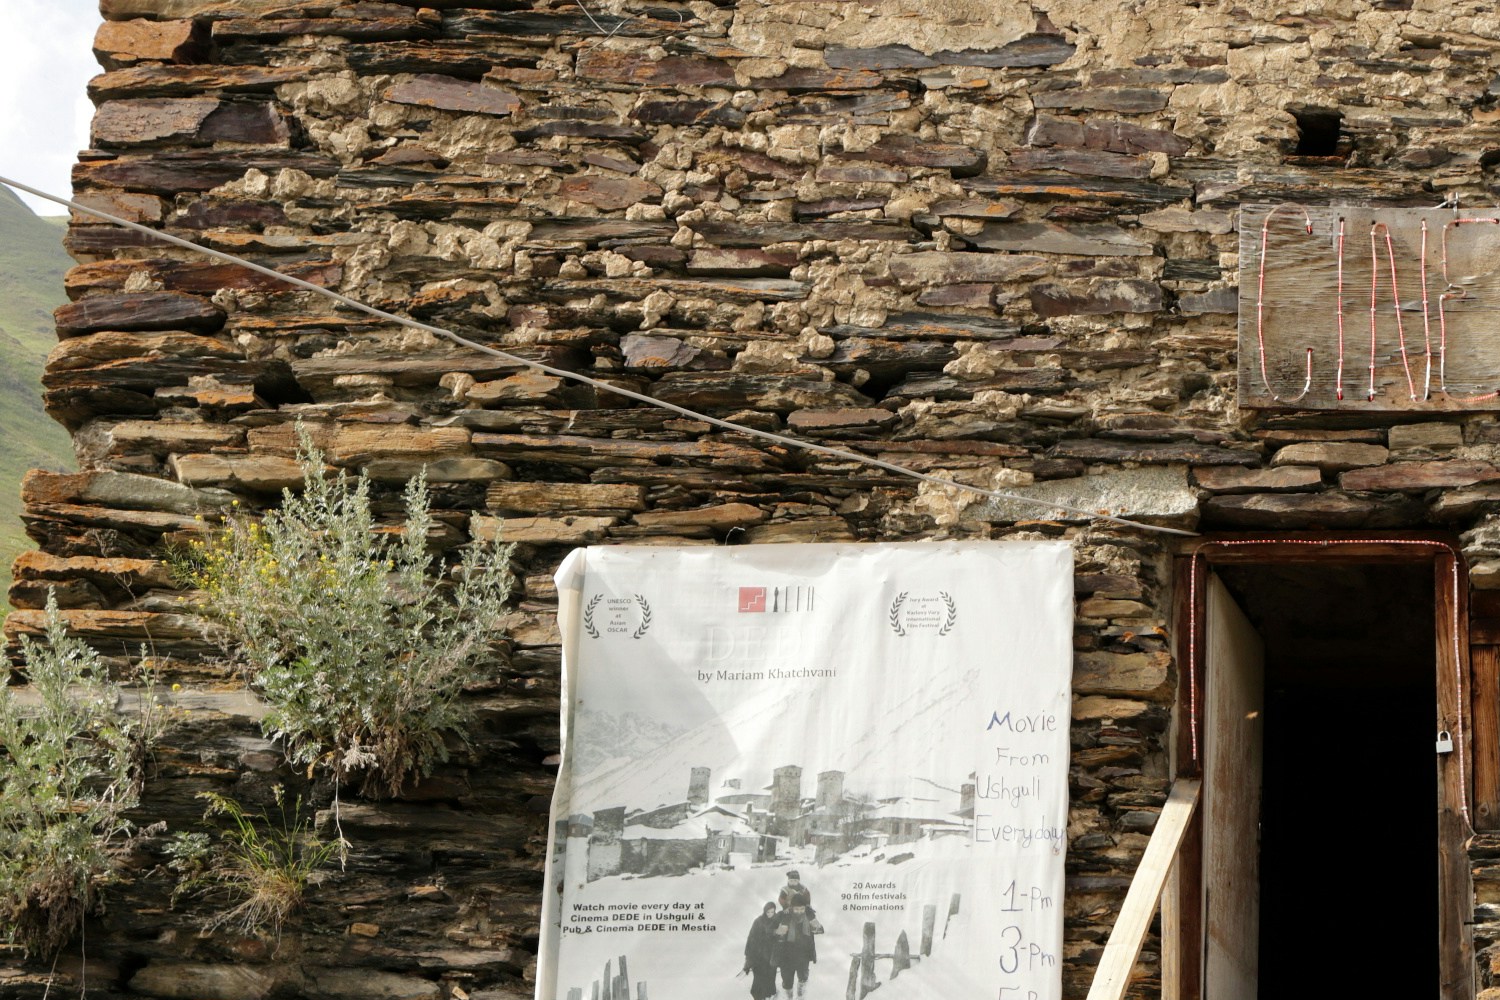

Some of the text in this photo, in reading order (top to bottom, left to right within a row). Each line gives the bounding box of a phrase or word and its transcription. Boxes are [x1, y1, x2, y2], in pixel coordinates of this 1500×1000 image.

[697, 666, 837, 684] by Mariam Khatchvani
[986, 709, 1057, 733] Movie
[996, 747, 1050, 766] From
[840, 892, 907, 901] 90 film festivals
[572, 902, 705, 912] Watch movie every day at
[849, 903, 904, 911] Nominations
[570, 914, 609, 923] Cinema
[612, 913, 640, 921] DEDE
[642, 913, 652, 921] in
[655, 912, 694, 922] Ushguli
[562, 923, 716, 934] Pub & Cinema DEDE in Mestia
